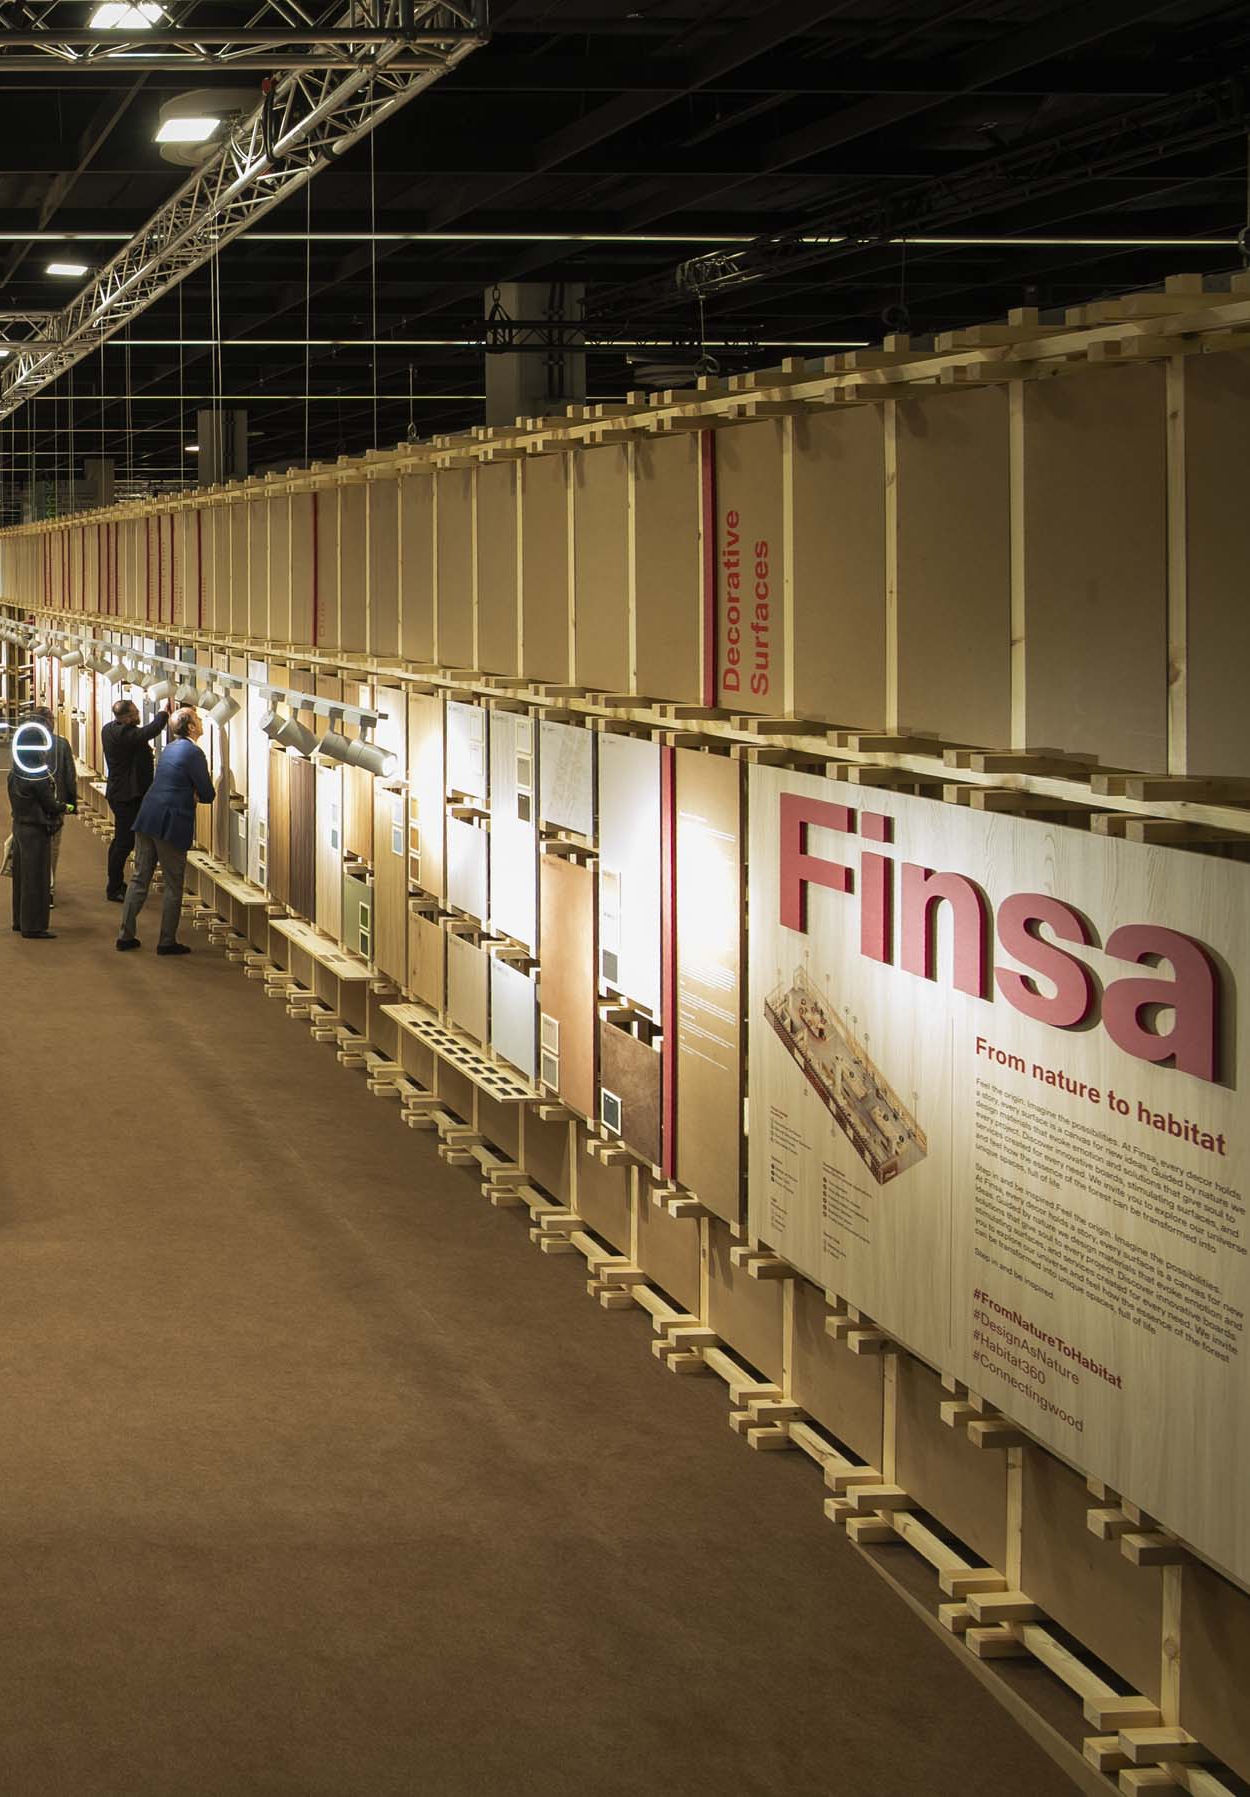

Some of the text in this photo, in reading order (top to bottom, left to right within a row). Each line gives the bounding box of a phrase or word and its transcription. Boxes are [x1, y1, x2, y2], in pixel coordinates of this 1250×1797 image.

[722, 510, 742, 693] Decorative
[750, 541, 770, 696] Surfaces
[779, 791, 1222, 1083] Finsa
[975, 1036, 1227, 1156] From nature to habitat
[973, 1287, 1123, 1390] #FromNatureToHabitat
[973, 1309, 1080, 1385] #DesignAsNature
[973, 1329, 1046, 1385] #Habitat360
[973, 1350, 1084, 1433] #Connectingwood
